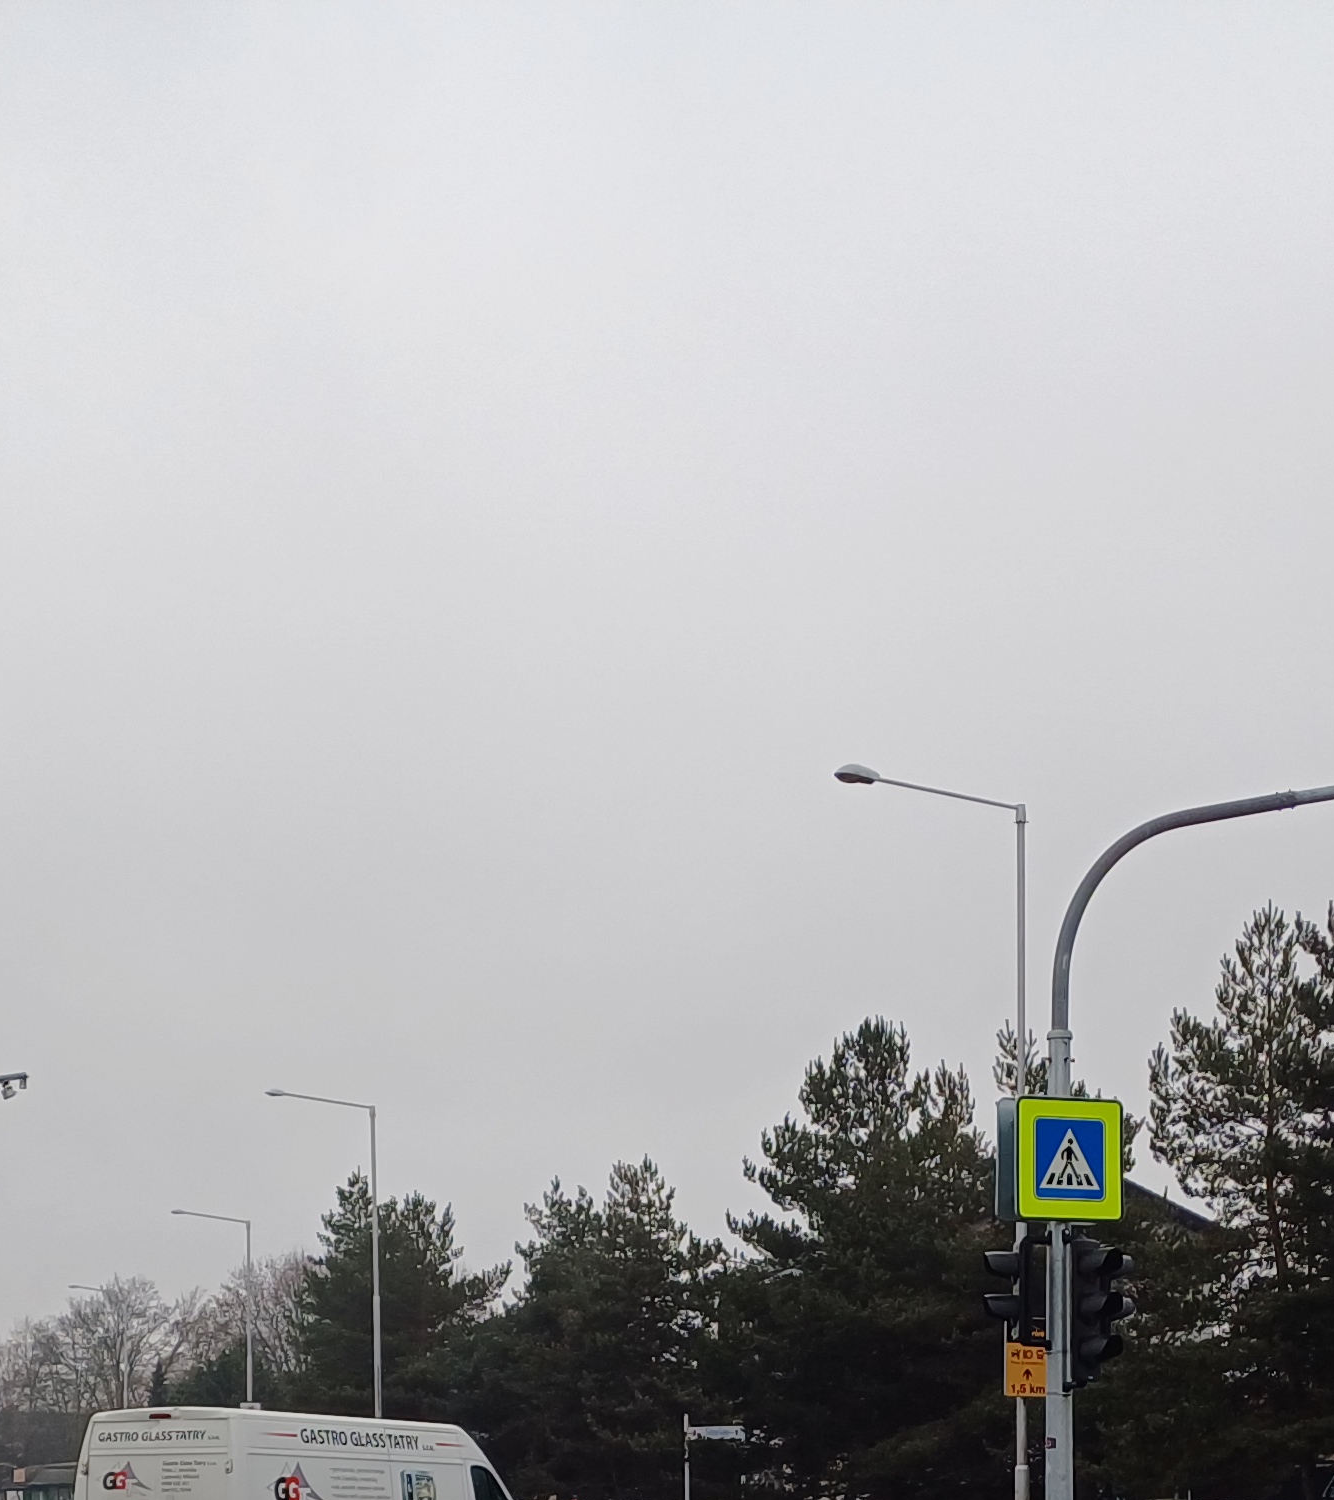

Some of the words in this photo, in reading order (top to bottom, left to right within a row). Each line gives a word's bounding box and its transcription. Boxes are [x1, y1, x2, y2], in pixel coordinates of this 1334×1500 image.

[1011, 1383, 1027, 1395] 1,5
[1030, 1383, 1045, 1394] km
[98, 1432, 139, 1442] GASTRO
[141, 1431, 173, 1441] GLASS
[174, 1430, 207, 1440] TATRY
[300, 1428, 348, 1445] GASTRO
[350, 1431, 386, 1448] GLASS
[386, 1433, 419, 1450] TATRY
